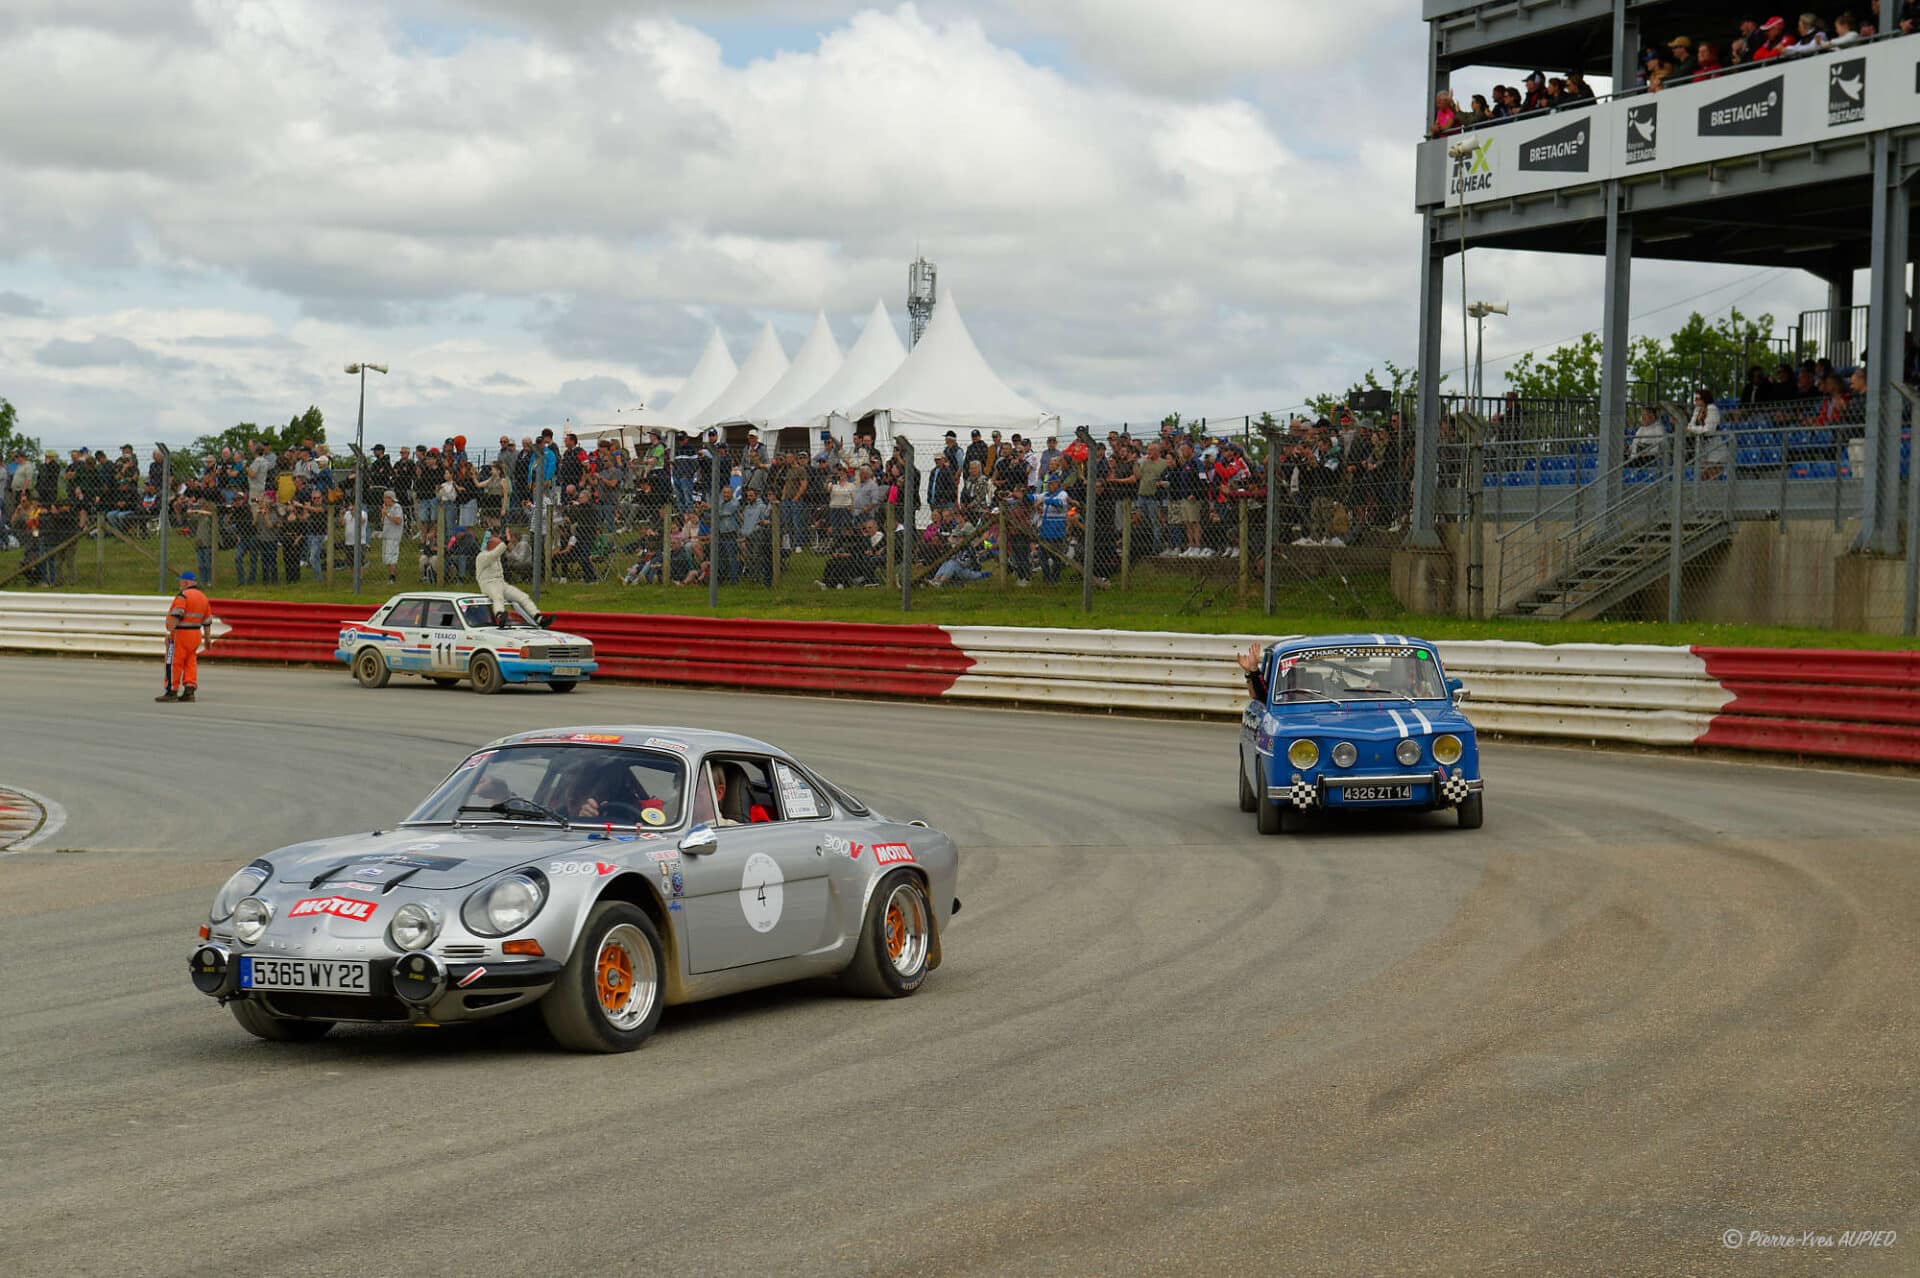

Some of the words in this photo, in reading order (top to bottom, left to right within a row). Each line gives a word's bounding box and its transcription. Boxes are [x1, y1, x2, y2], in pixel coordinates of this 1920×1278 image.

[1710, 101, 1769, 127] BRETAGNE
[1529, 139, 1578, 162] BRETAGNE
[1451, 172, 1493, 195] LOHEAC
[434, 632, 457, 640] TEXACO
[435, 642, 452, 665] 11
[1344, 787, 1376, 800] 4326
[1377, 786, 1393, 799] ZT
[1396, 785, 1410, 798] 14
[824, 833, 864, 860] 300V
[876, 845, 913, 862] MOTUL
[549, 861, 620, 876] 300V
[757, 880, 767, 908] 4
[292, 898, 370, 918] MOTUL
[254, 961, 304, 986] 5365
[309, 963, 334, 987] WY
[338, 964, 365, 989] 22
